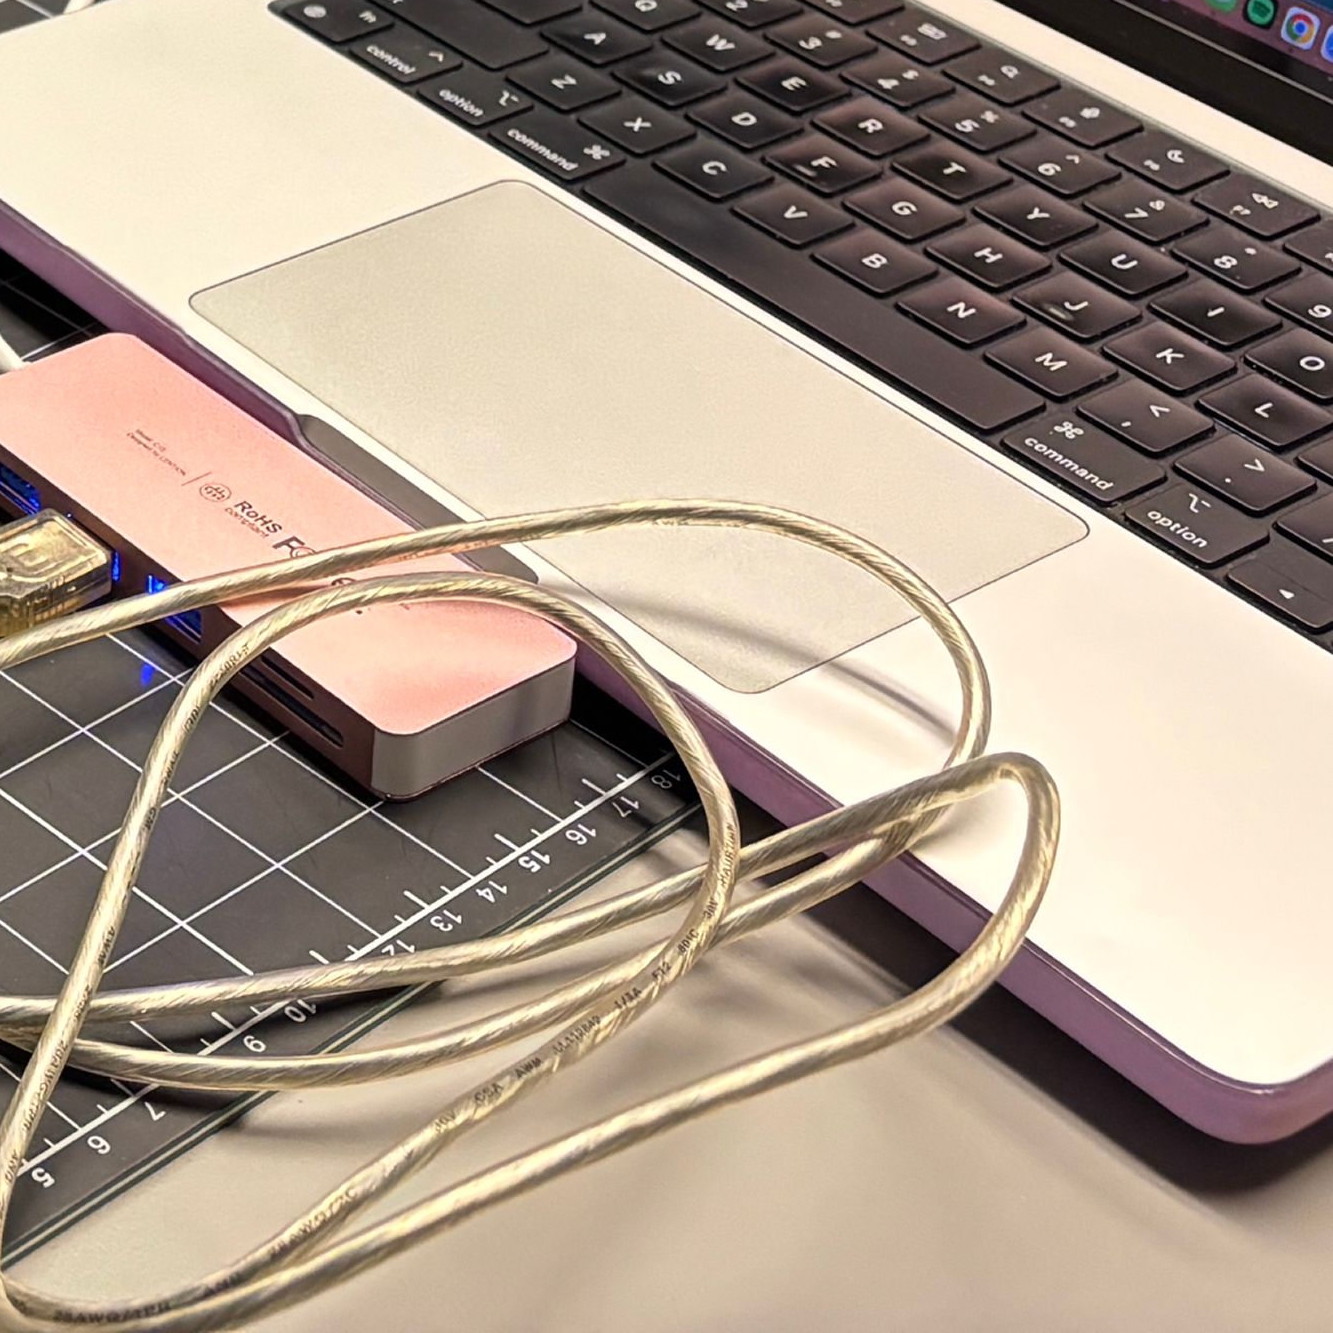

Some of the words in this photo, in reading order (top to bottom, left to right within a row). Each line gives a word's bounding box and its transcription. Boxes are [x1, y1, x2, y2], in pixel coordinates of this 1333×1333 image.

[584, 32, 608, 47] A
[706, 34, 735, 53] W
[366, 42, 417, 77] control
[551, 74, 578, 90] Z
[657, 70, 682, 87] S
[781, 76, 808, 93] E
[438, 87, 485, 119] option
[624, 117, 652, 133] X
[732, 110, 758, 128] D
[858, 117, 885, 135] R
[954, 118, 981, 134] 5
[507, 126, 580, 173] command
[701, 160, 728, 177] C
[811, 155, 838, 173] F
[942, 161, 967, 179] T
[1037, 161, 1062, 177] 6
[782, 204, 808, 222] V
[890, 200, 918, 217] G
[1026, 206, 1051, 224] Y
[1124, 206, 1150, 222] 7
[861, 251, 890, 270] B
[973, 247, 1004, 265] H
[1110, 253, 1139, 271] U
[1213, 254, 1239, 270] 8
[946, 300, 978, 321] N
[1063, 299, 1090, 313] J
[1307, 303, 1333, 320] 9
[1034, 351, 1069, 372] M
[1155, 346, 1186, 365] K
[1298, 354, 1327, 373] O
[1253, 401, 1275, 419] L
[1023, 435, 1114, 492] command
[234, 499, 283, 534] RoHS
[1146, 507, 1210, 550] option
[649, 768, 682, 790] 18
[611, 795, 641, 820] 17
[564, 821, 599, 847] 16
[516, 848, 552, 874] 15
[474, 879, 509, 905] 14
[429, 908, 463, 934] 13
[283, 998, 318, 1024] 10
[473, 1081, 504, 1107] CSA
[514, 1055, 544, 1081] AWM
[142, 1101, 168, 1123] 7
[30, 1166, 56, 1189] 5
